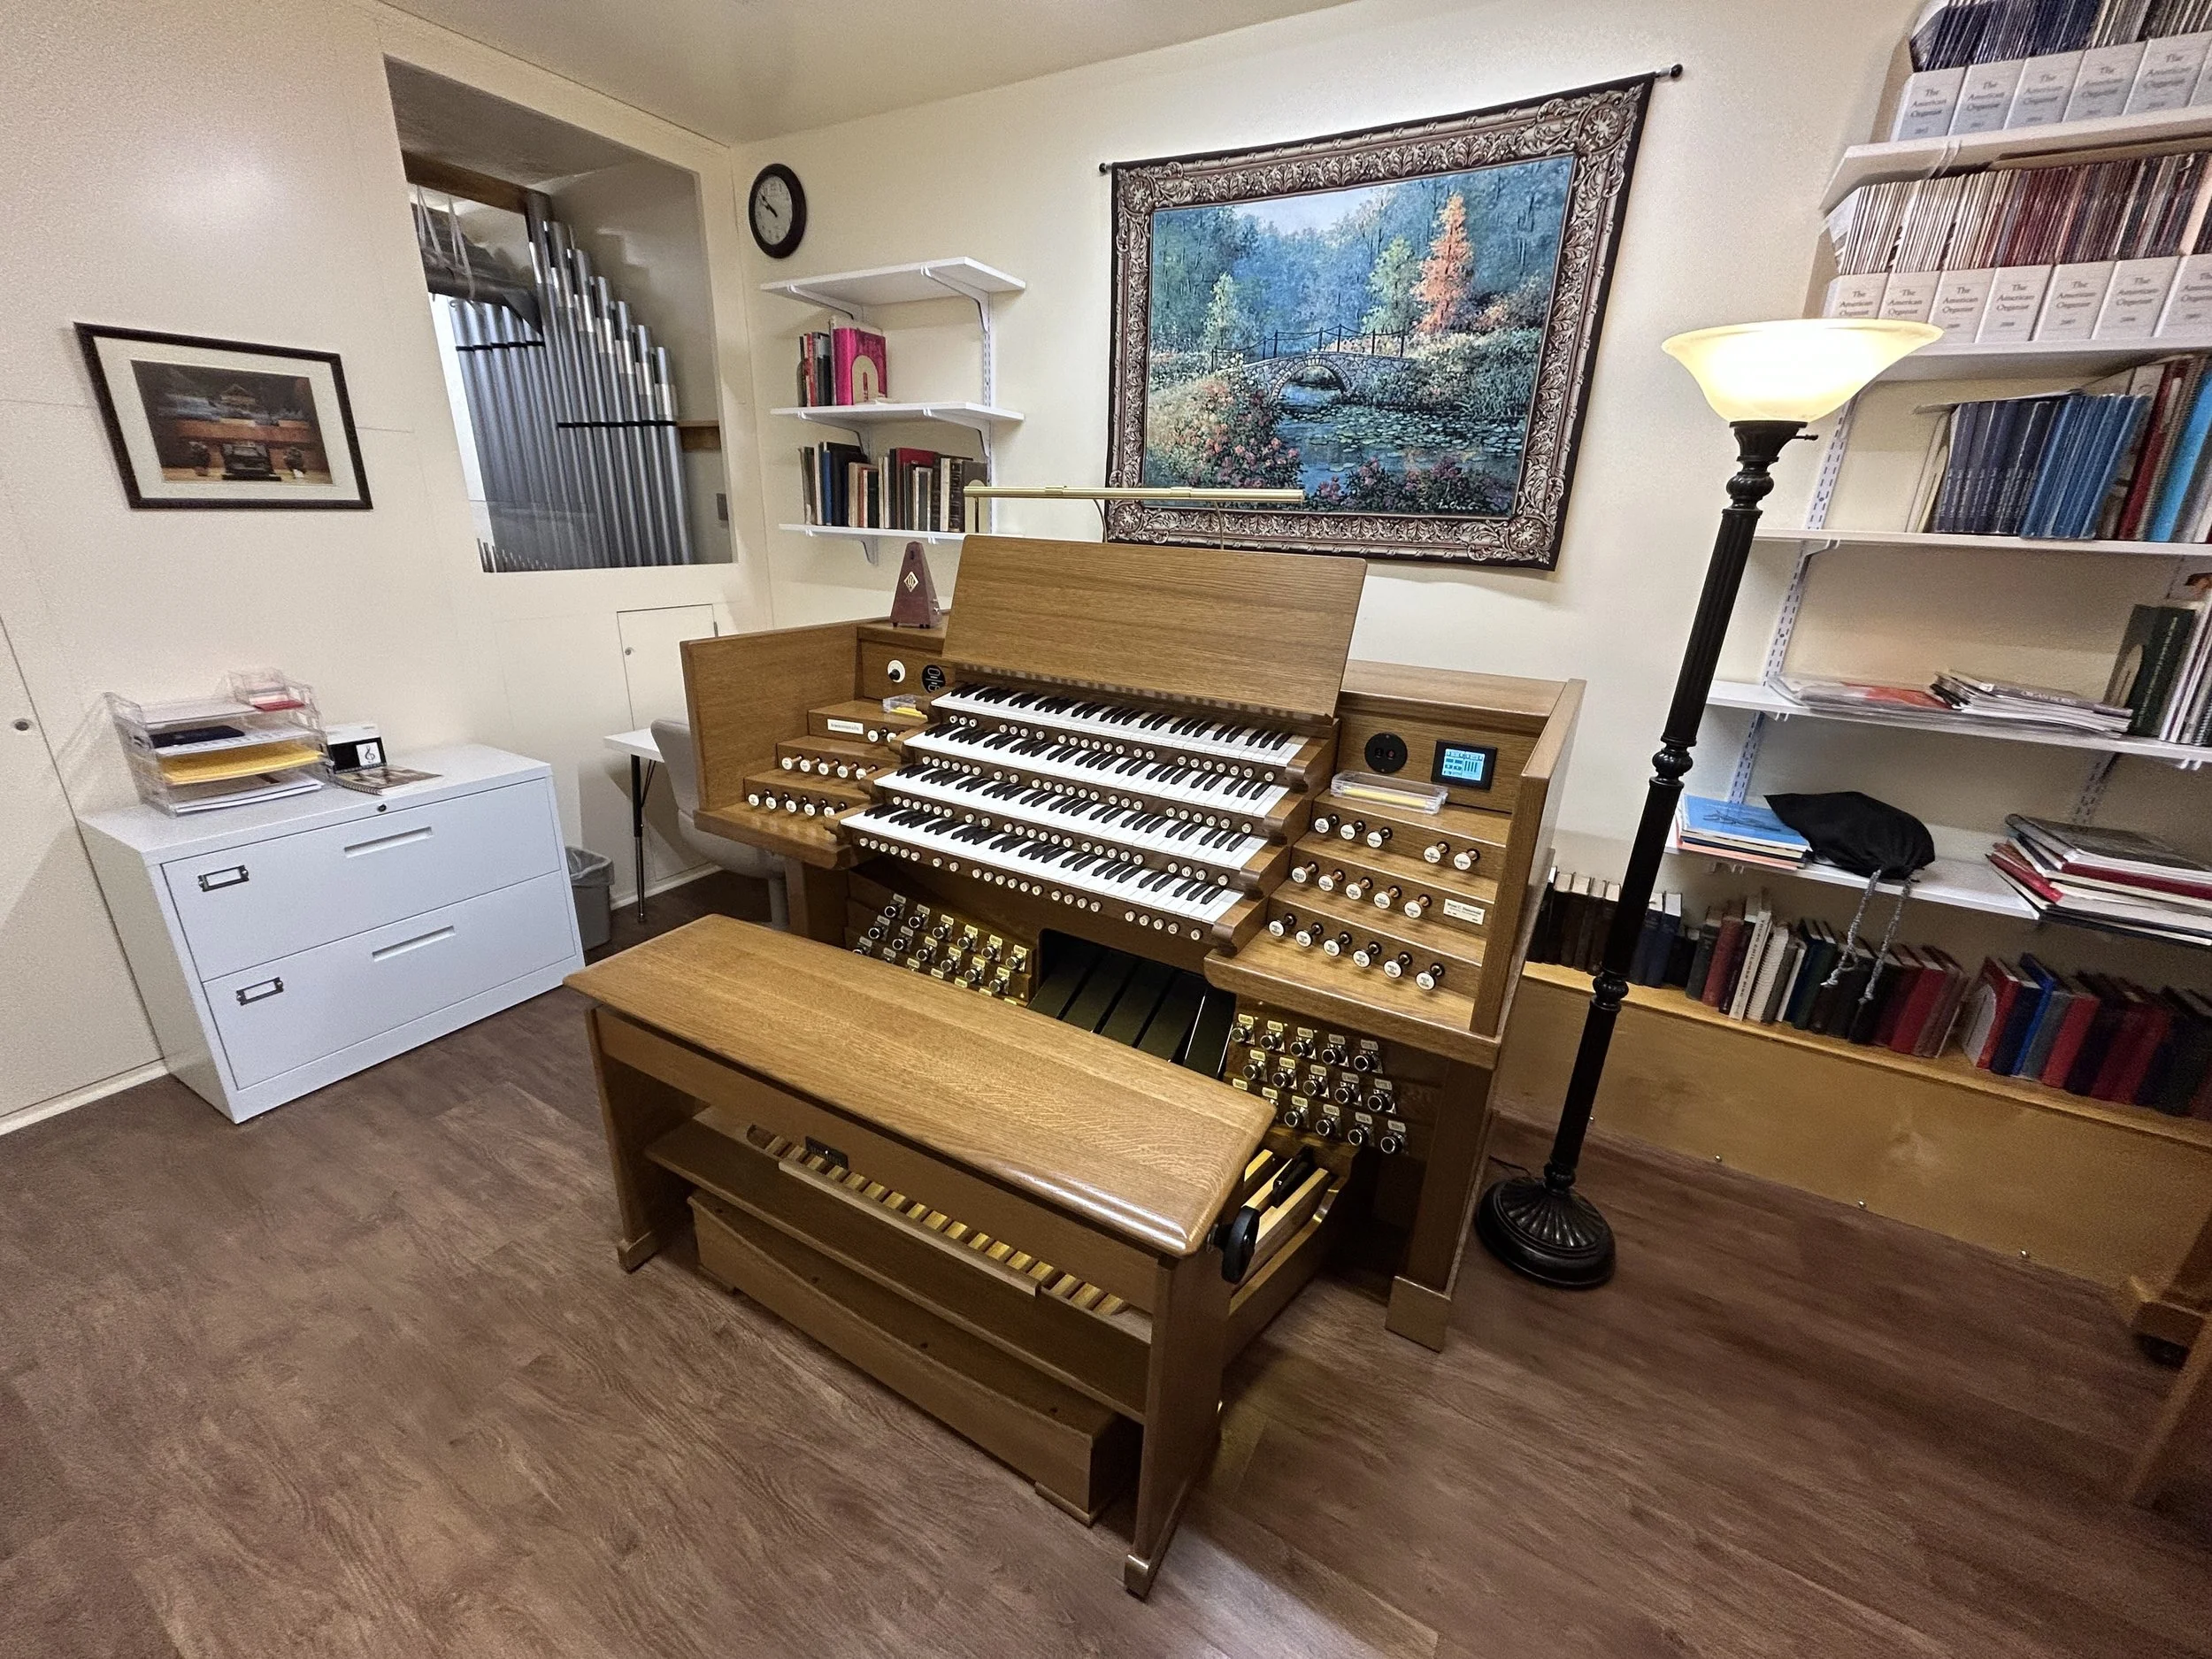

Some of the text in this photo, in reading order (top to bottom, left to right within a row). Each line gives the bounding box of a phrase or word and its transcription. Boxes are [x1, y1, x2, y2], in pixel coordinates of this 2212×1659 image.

[1902, 288, 1916, 296] The
[1956, 286, 1971, 295] The
[2011, 283, 2028, 292] The
[1852, 289, 1867, 298] The
